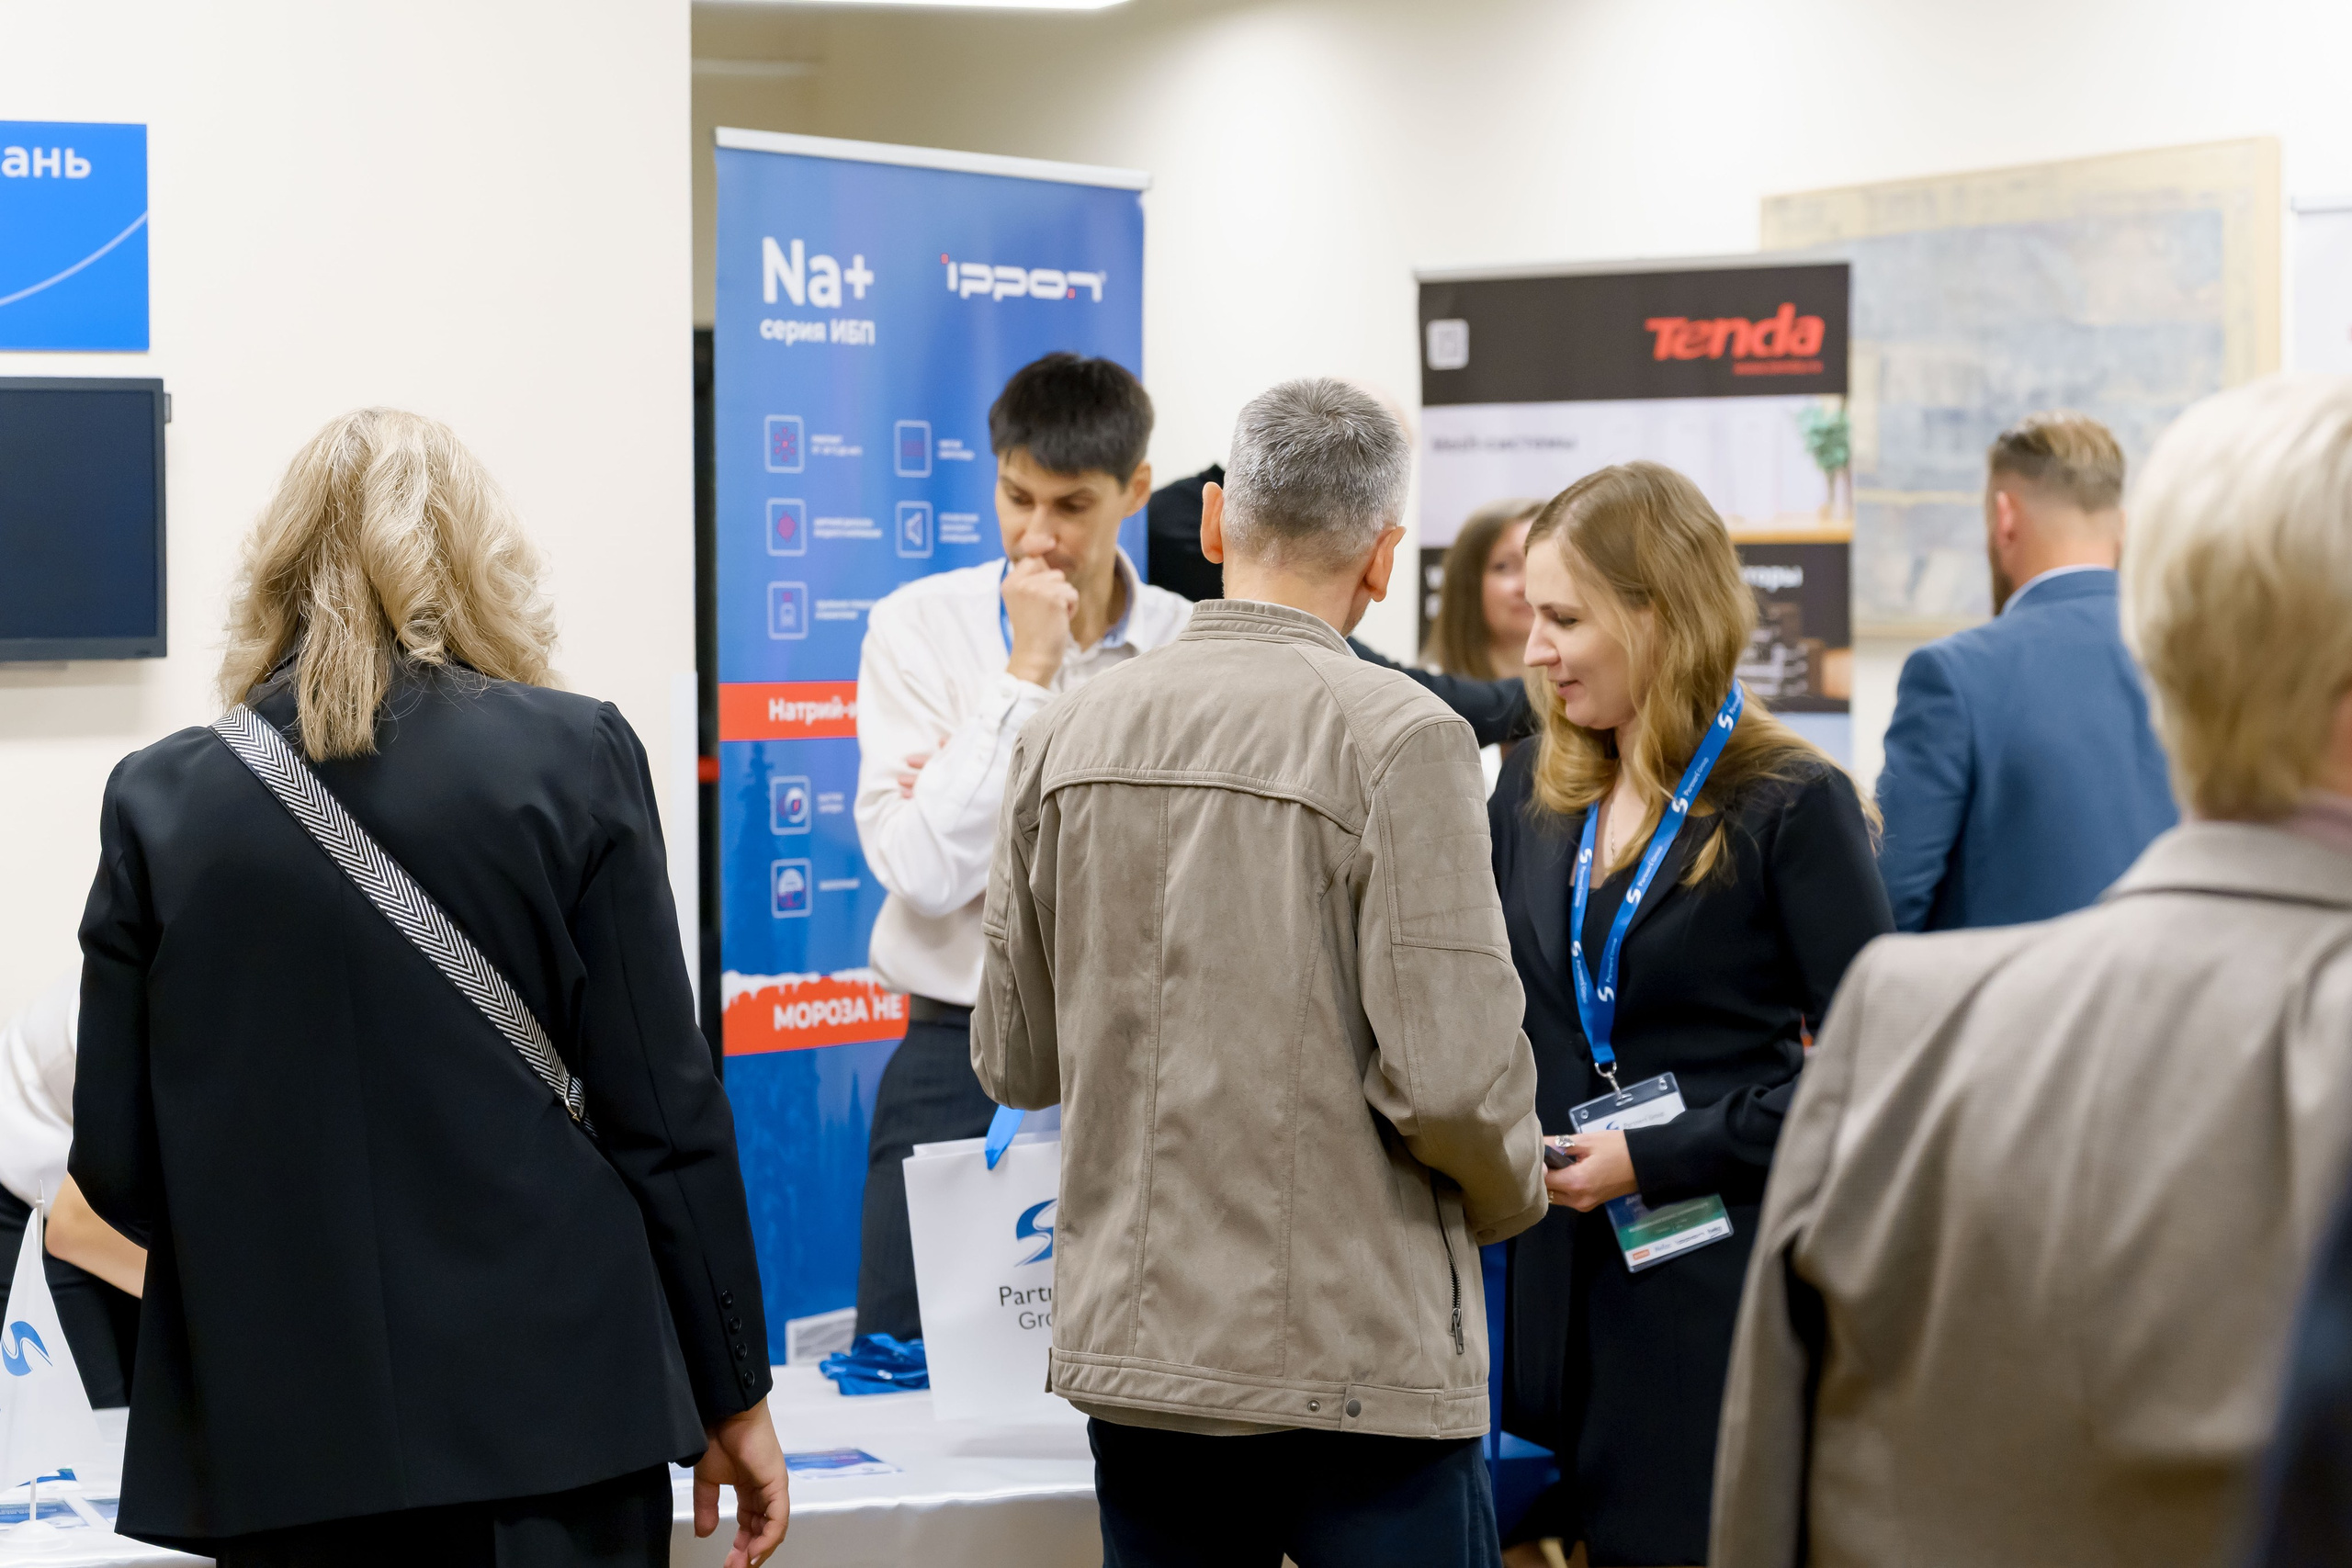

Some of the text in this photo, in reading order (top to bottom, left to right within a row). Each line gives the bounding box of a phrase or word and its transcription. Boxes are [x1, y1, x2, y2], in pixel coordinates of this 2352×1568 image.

[1, 146, 91, 179] ань
[762, 236, 874, 308] Na+
[941, 253, 1105, 302] ippon
[760, 318, 875, 346] серия ИБП
[1645, 302, 1825, 359] Tenda
[774, 994, 902, 1031] МОРОЗА НЕ
